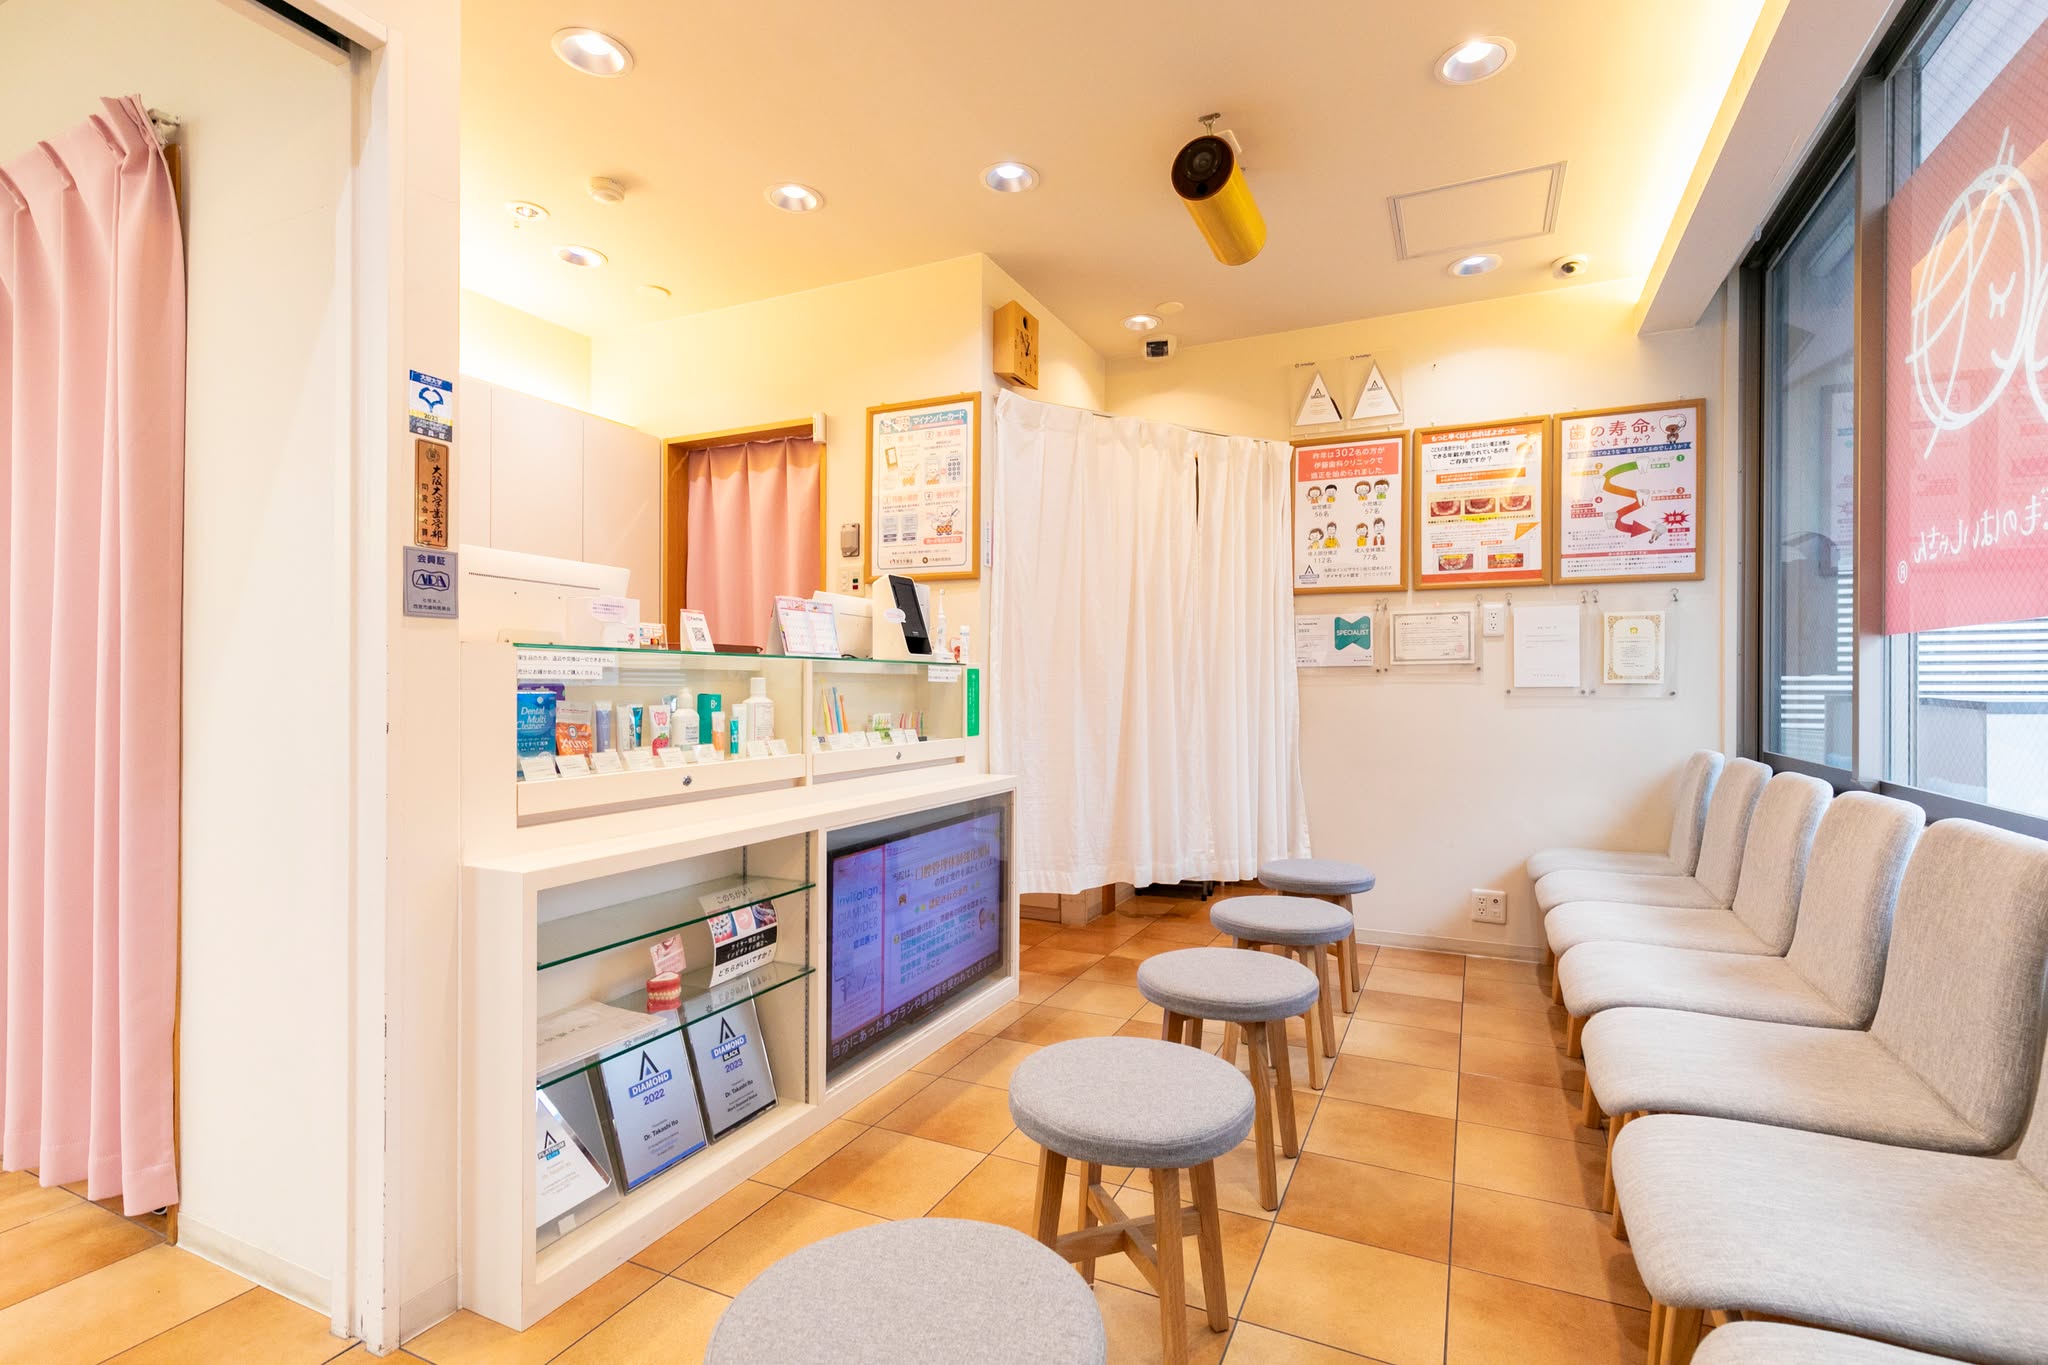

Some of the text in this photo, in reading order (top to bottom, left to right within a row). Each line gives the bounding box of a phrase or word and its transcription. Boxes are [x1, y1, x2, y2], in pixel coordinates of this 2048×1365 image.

[912, 411, 966, 425] マイナンバーカード
[1568, 418, 1656, 441] 歯の寿命を
[1312, 447, 1385, 459] 昨年は302名の方が
[1432, 447, 1509, 460] できる年齢が限られているのを
[1314, 457, 1383, 469] 伊藤歯科クリニックで
[1310, 467, 1385, 479] 矯正を始められました。
[430, 465, 443, 542] 大阪大学歯学部
[417, 554, 445, 566] 会員証
[521, 706, 545, 715] Dental
[527, 715, 546, 723] Multi
[838, 901, 878, 925] DIAMOND
[836, 917, 878, 940] PROVIDER
[718, 949, 772, 977] どちらがいいですか？
[713, 1037, 745, 1057] DIAMOND
[723, 1049, 739, 1060] BLACK
[725, 1058, 743, 1073] 2023
[631, 1071, 670, 1096] DIAMOND
[643, 1088, 665, 1106] 2022
[651, 1124, 671, 1137] Takashi
